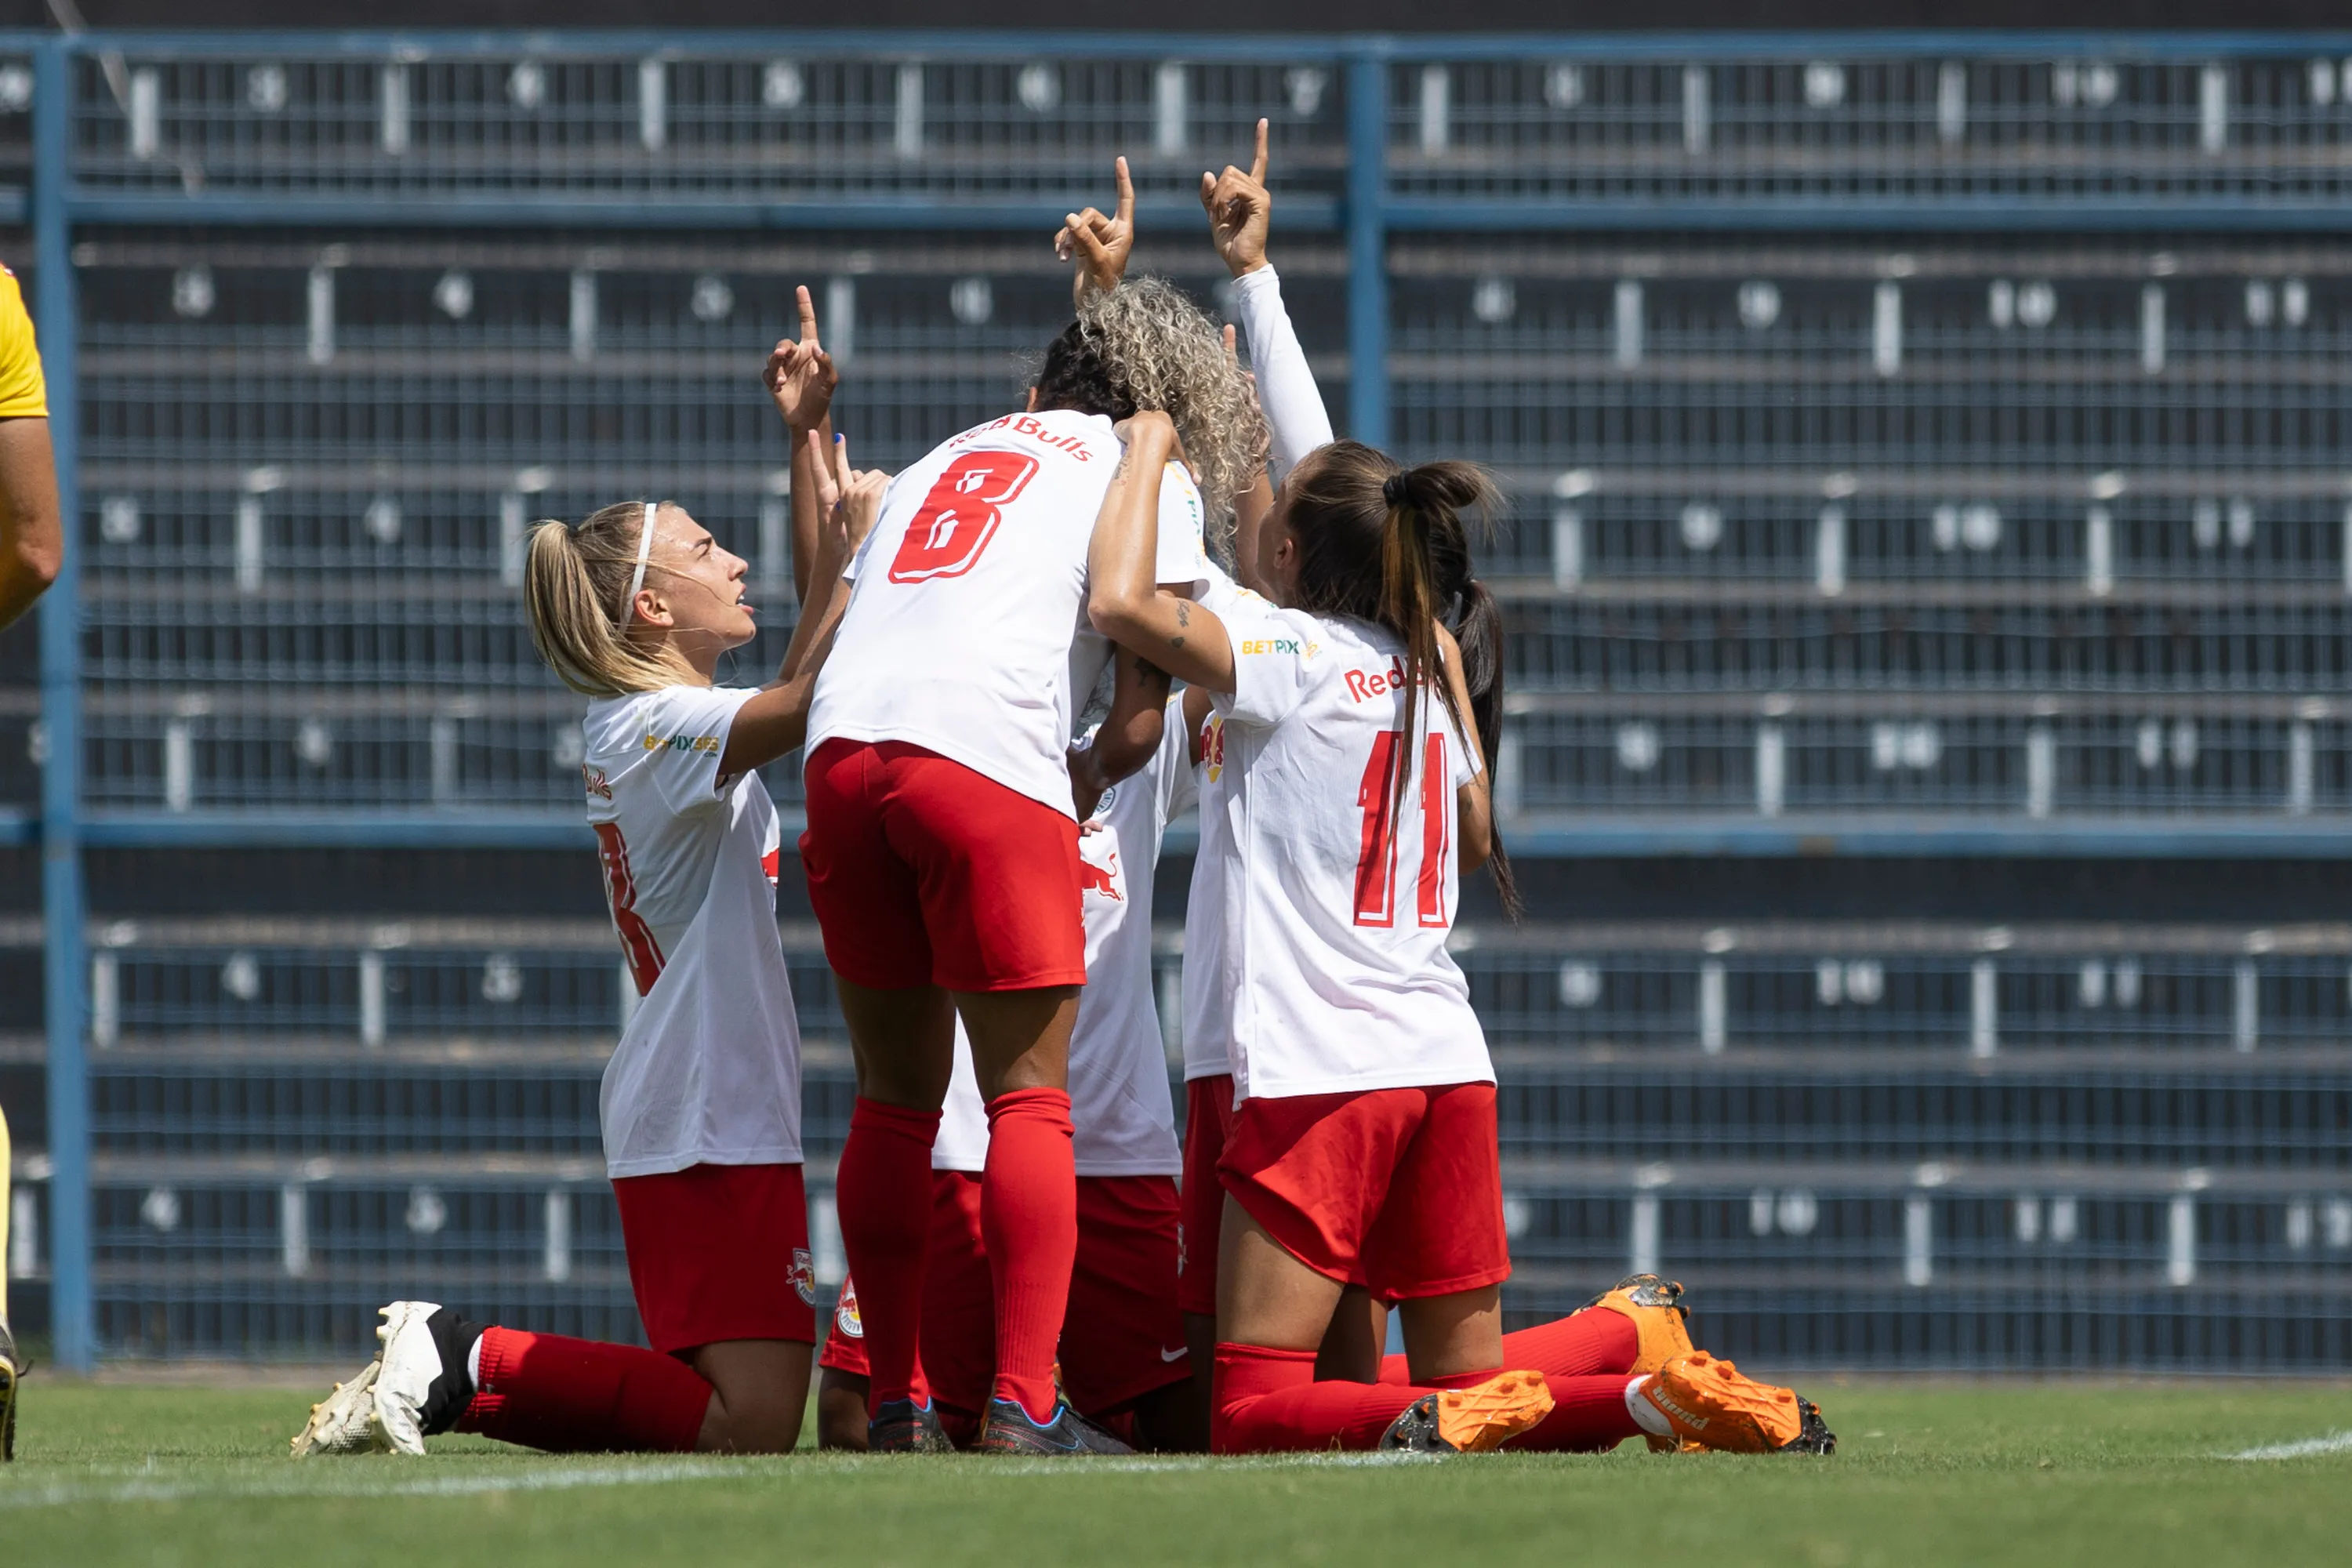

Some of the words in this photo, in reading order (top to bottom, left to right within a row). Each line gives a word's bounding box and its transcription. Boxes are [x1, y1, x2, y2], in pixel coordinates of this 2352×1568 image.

[1012, 416, 1094, 462] Bulls
[887, 451, 1040, 585] 8
[1344, 655, 1407, 704] Red
[1353, 730, 1450, 929] 11
